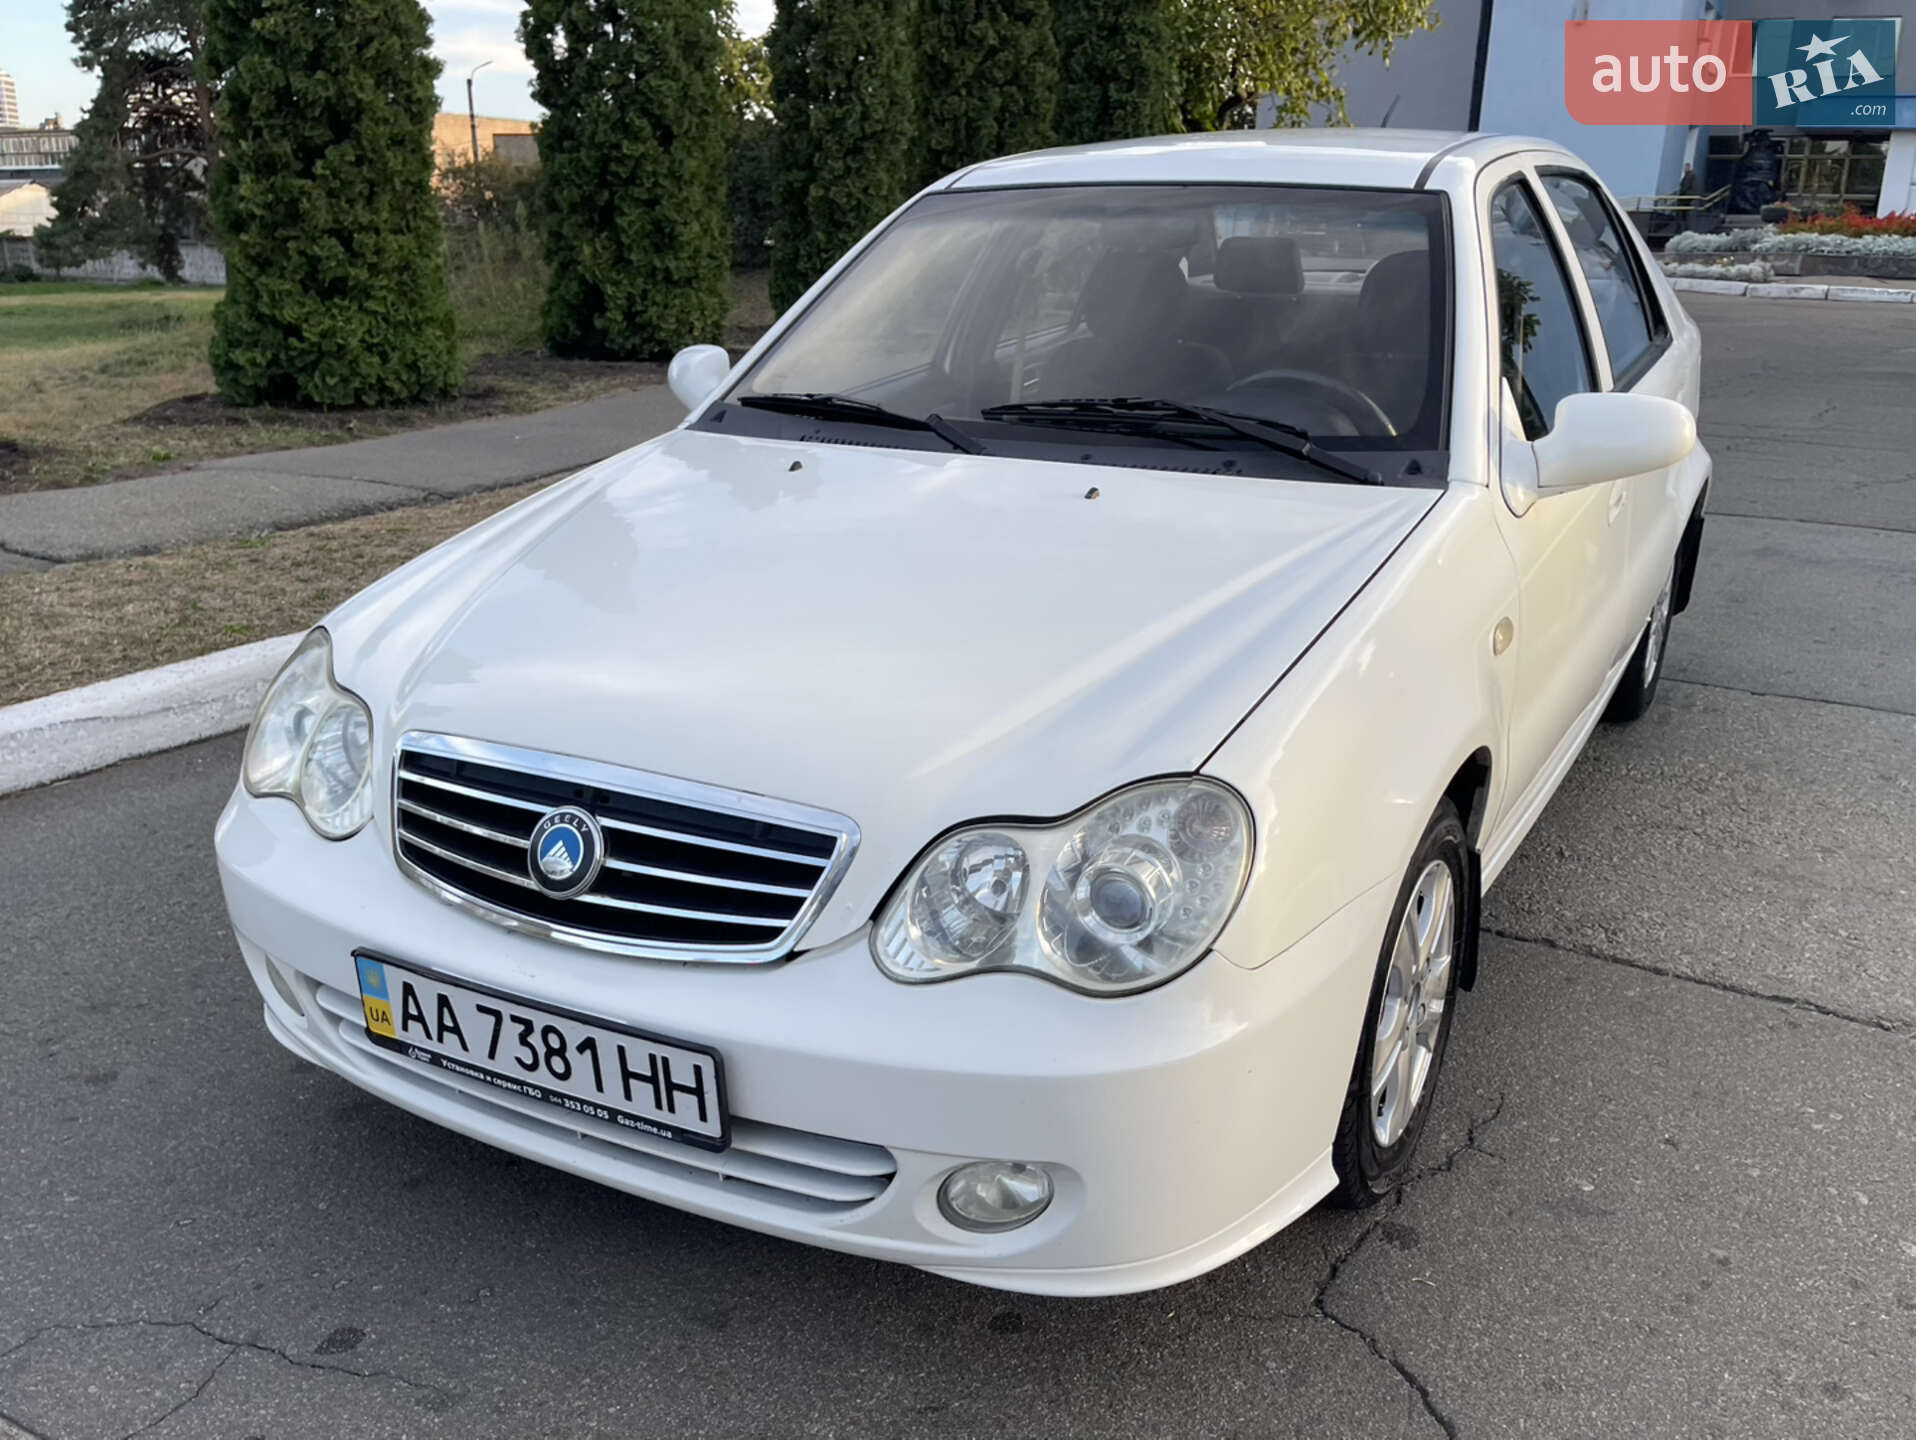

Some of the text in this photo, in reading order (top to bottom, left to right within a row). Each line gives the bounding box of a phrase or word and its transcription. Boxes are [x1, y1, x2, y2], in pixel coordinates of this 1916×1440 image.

[369, 1006, 392, 1026] UA
[401, 980, 708, 1123] AA 7381 HH
[440, 1058, 485, 1081] Установка
[492, 1078, 523, 1093] сервис
[523, 1085, 542, 1098] ГБО
[563, 1098, 582, 1111] 353
[583, 1104, 595, 1115] 05
[596, 1108, 609, 1120] 05
[616, 1115, 673, 1139] Gaz-time.ua
